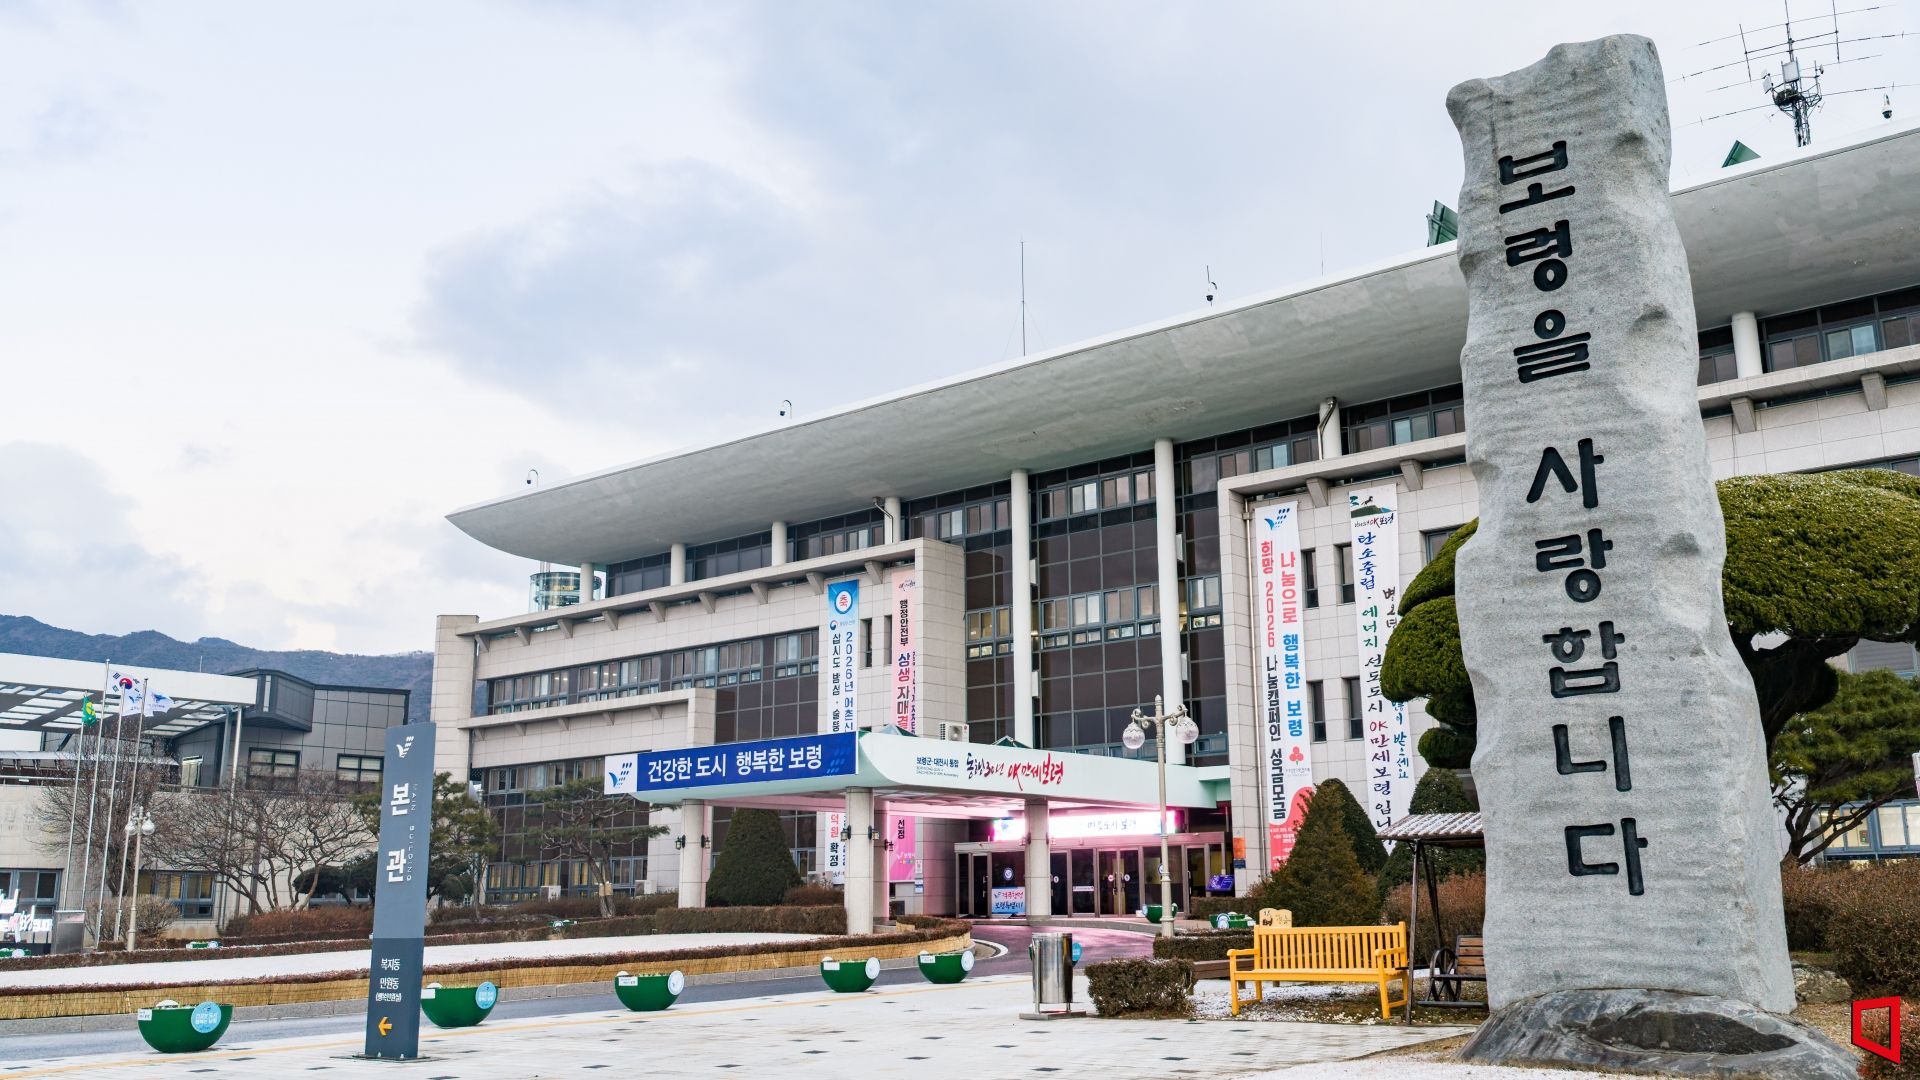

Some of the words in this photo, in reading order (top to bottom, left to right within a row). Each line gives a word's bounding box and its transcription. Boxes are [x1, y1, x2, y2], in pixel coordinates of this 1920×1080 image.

[1498, 140, 1591, 384] 보령을
[1261, 540, 1274, 574] 희망
[1280, 552, 1298, 624] 나눔으로
[899, 599, 908, 647] 행정안전부
[1266, 581, 1275, 648] 2026
[1362, 605, 1378, 648] 에너지
[832, 633, 841, 668] 삽시도
[844, 631, 853, 693] 2026년
[898, 652, 910, 682] 상생
[1283, 633, 1301, 690] 행복한
[1526, 437, 1648, 896] 사랑합니다
[1266, 654, 1281, 742] 나눔캠페인
[1287, 700, 1303, 737] 보령
[648, 757, 693, 783] 건강한
[695, 753, 727, 778] 도시
[736, 748, 785, 775] 행복한
[789, 744, 822, 770] 보령
[1394, 731, 1409, 779] 받으세요
[1270, 748, 1286, 820] 성금모금
[1369, 720, 1392, 846] OK만세보령입니
[386, 783, 410, 883] 본관
[898, 819, 905, 839] 선정
[406, 825, 415, 882] BUILDING
[829, 842, 839, 867] 확정
[380, 977, 399, 990] 민원동
[381, 958, 401, 971] 복지동
